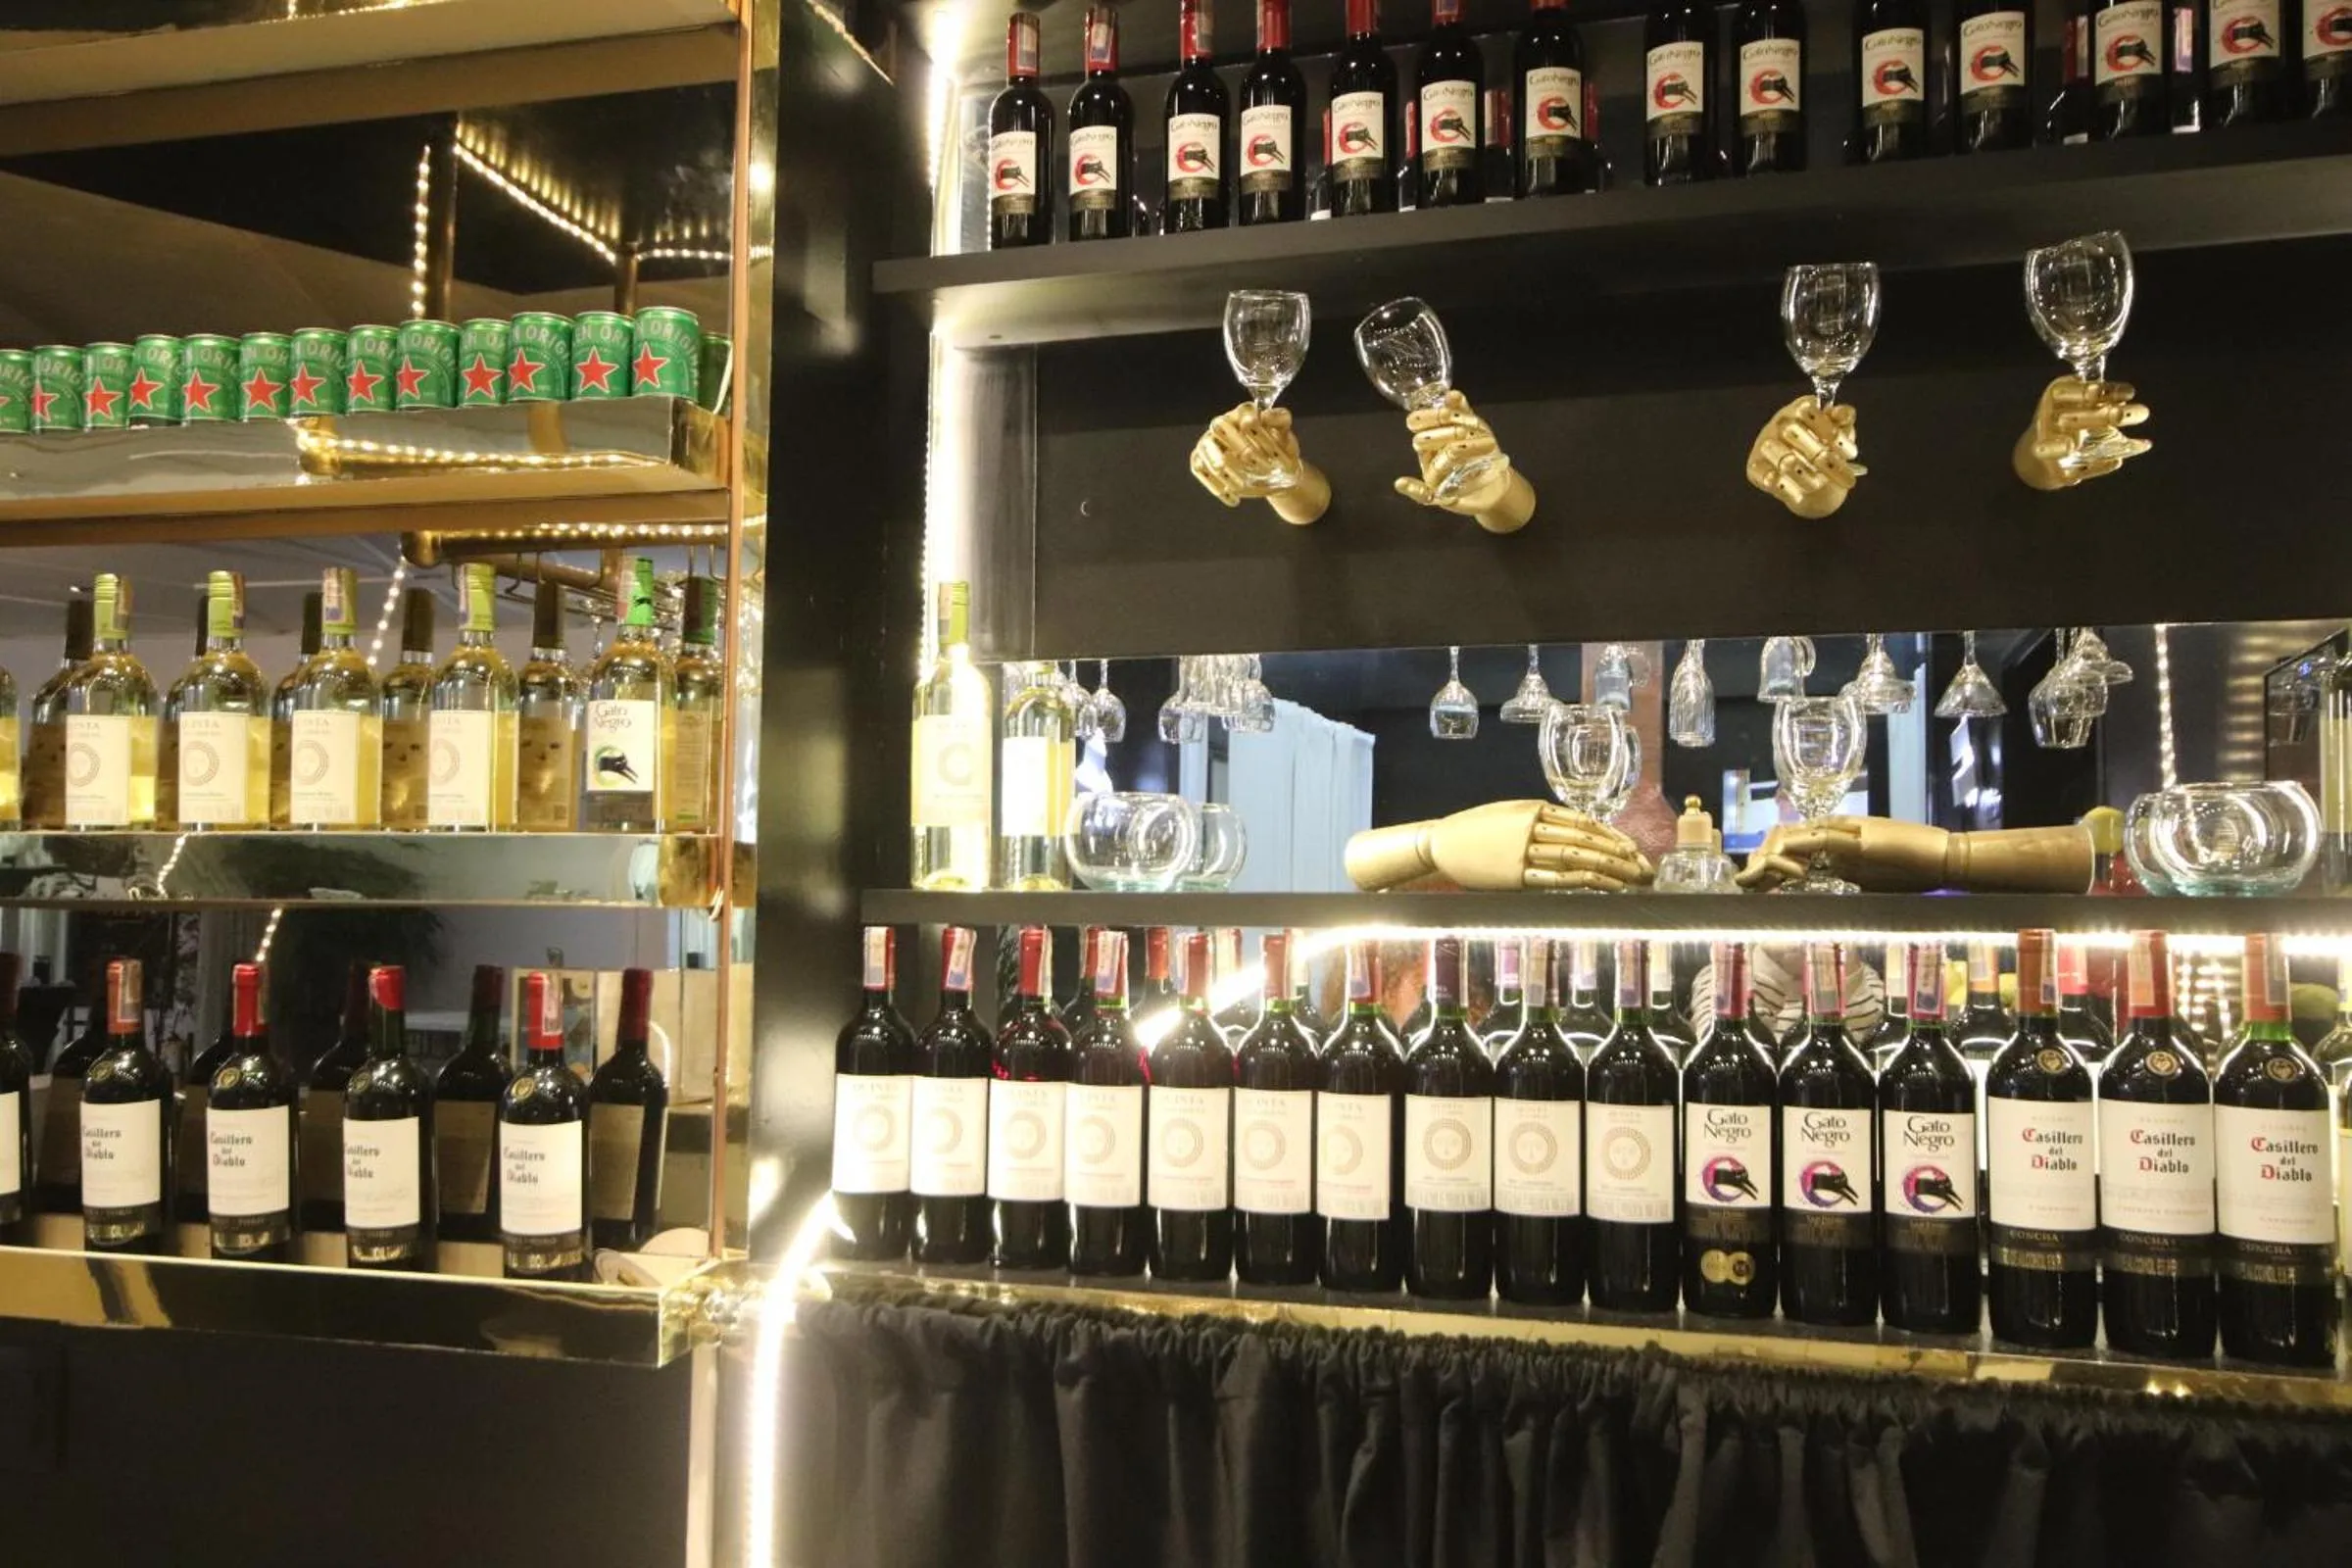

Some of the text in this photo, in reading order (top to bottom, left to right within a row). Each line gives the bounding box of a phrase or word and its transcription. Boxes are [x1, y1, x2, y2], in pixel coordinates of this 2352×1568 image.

[1706, 1107, 1748, 1127] Gato
[1803, 1111, 1847, 1130] Gato
[1906, 1115, 1951, 1133] Gato
[1704, 1124, 1752, 1144] Negro
[1800, 1126, 1851, 1149] Negro
[1903, 1131, 1956, 1152] Negro
[2022, 1127, 2083, 1145] Casillero
[2130, 1129, 2196, 1147] Casillero
[2157, 1149, 2174, 1158] del
[2250, 1138, 2320, 1154] Casillero
[2031, 1154, 2078, 1171] Diablo
[2138, 1156, 2190, 1174] Diablo
[2279, 1156, 2296, 1166] del
[2260, 1164, 2313, 1182] Diablo
